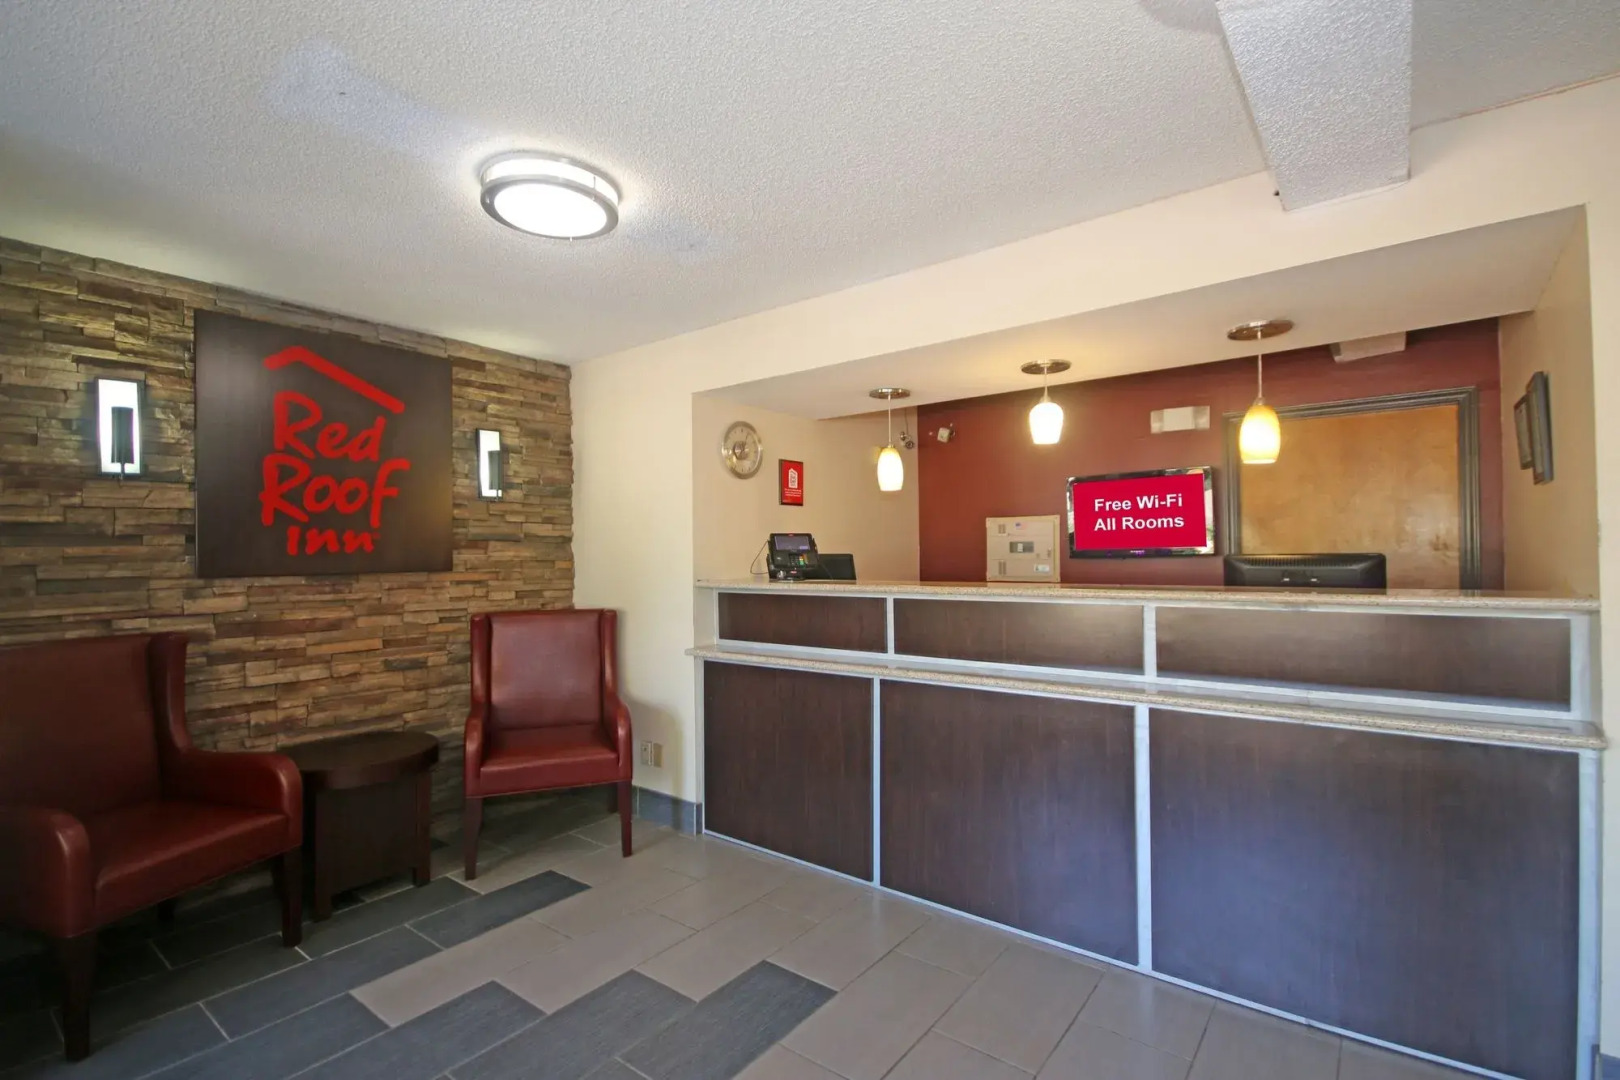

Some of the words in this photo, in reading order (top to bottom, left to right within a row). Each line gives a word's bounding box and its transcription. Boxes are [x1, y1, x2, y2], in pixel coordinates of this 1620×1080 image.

[273, 390, 387, 462] Red
[259, 452, 412, 529] Roof
[1094, 498, 1132, 511] Free
[1136, 493, 1183, 509] Wi-Fi
[1094, 516, 1116, 531] All
[1122, 515, 1185, 530] Rooms
[286, 525, 375, 555] Inn
